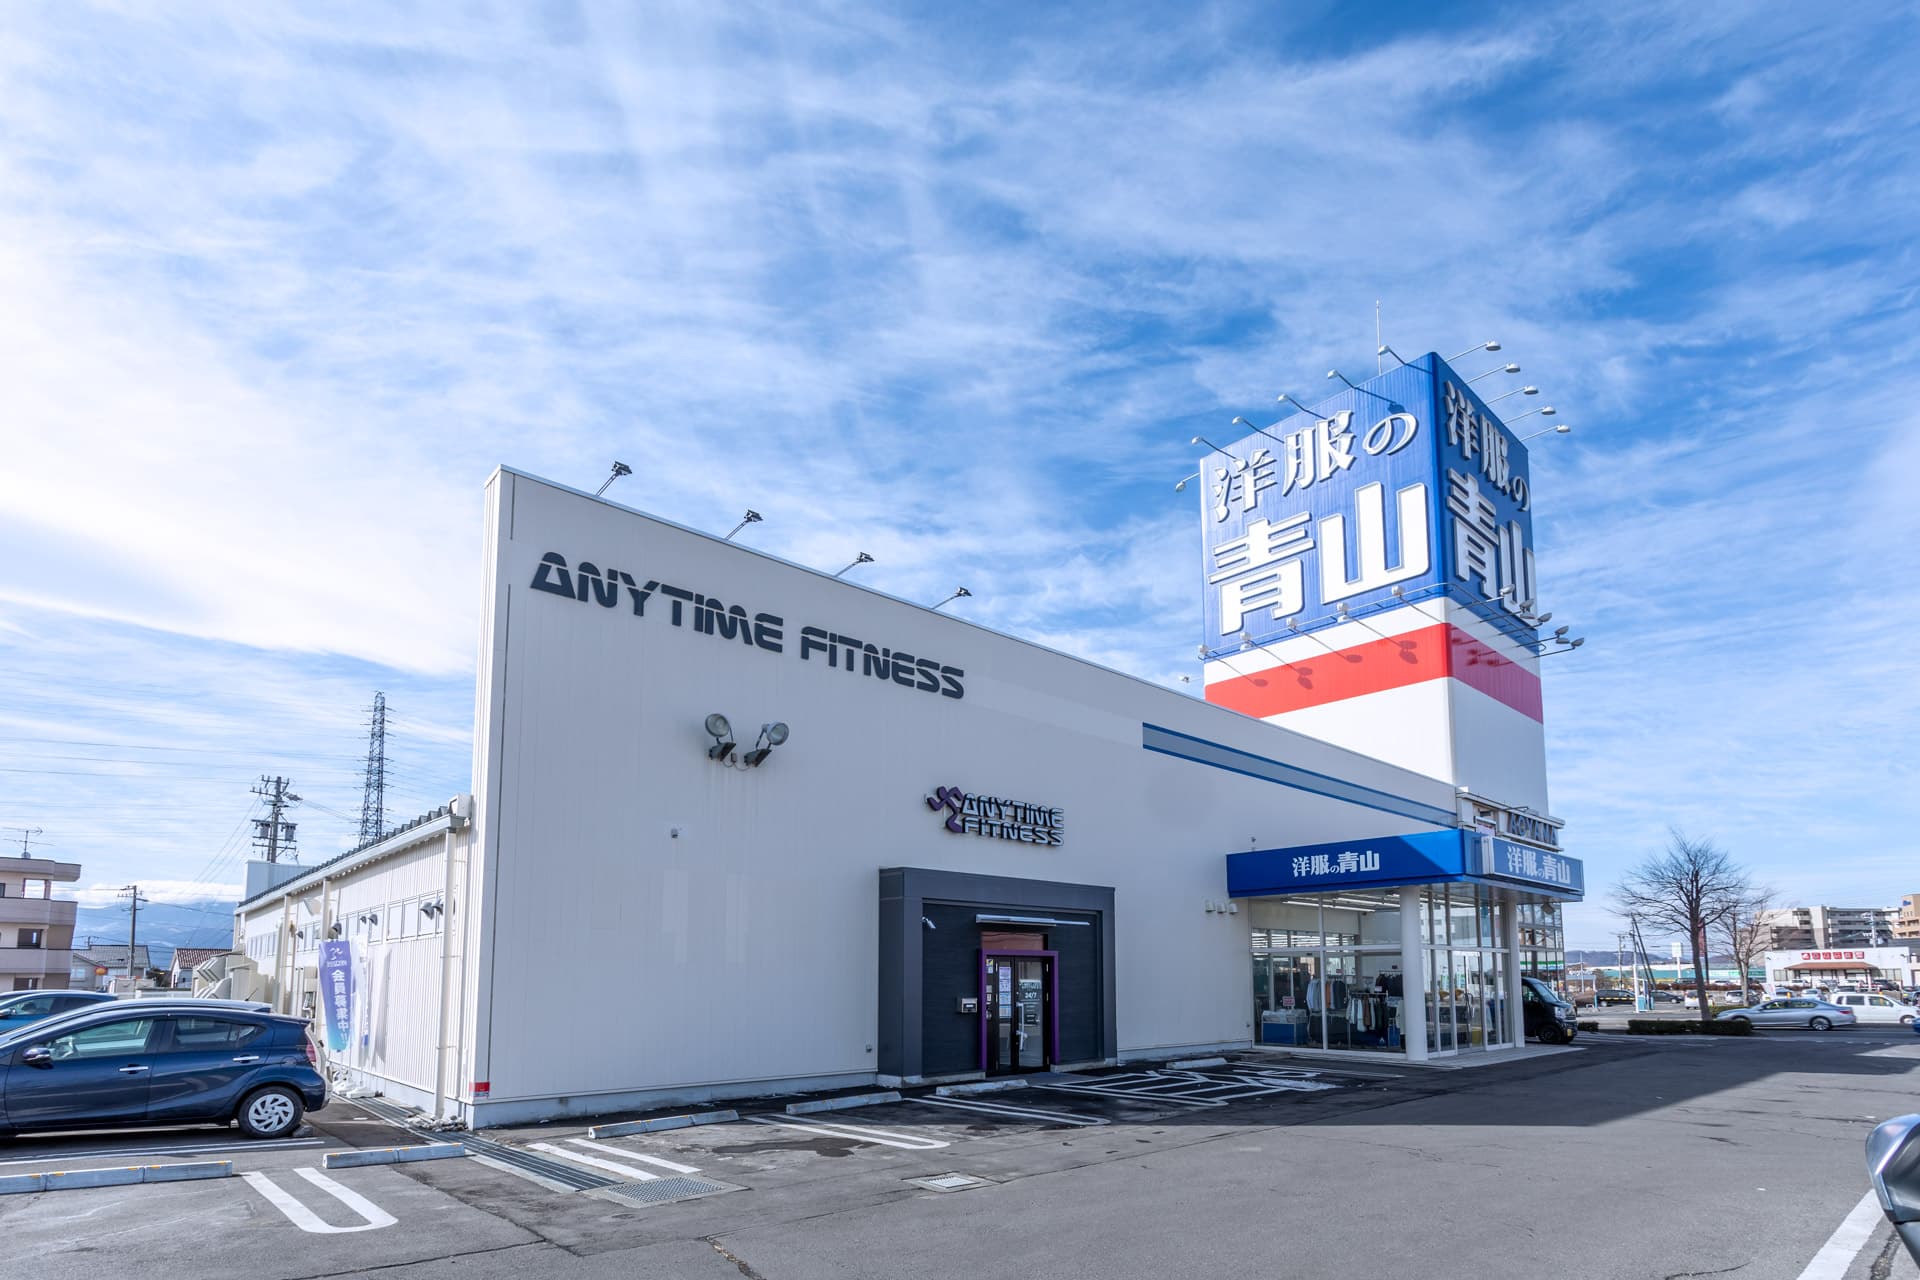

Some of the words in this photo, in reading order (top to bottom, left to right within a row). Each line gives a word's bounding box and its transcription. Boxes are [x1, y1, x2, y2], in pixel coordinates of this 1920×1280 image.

[1213, 410, 1419, 522] 洋服の
[1445, 380, 1531, 511] 洋服の
[1208, 481, 1430, 635] 青山
[1446, 468, 1538, 626] 青山
[530, 551, 783, 653] ANYTIME
[801, 625, 964, 699] FITNESS
[962, 793, 1064, 828] ANYTIME
[963, 817, 1064, 846] FITNESS
[1510, 812, 1558, 846] AOYAMA
[1292, 850, 1380, 878] 洋服の青山
[1507, 846, 1571, 884] 洋服の青山
